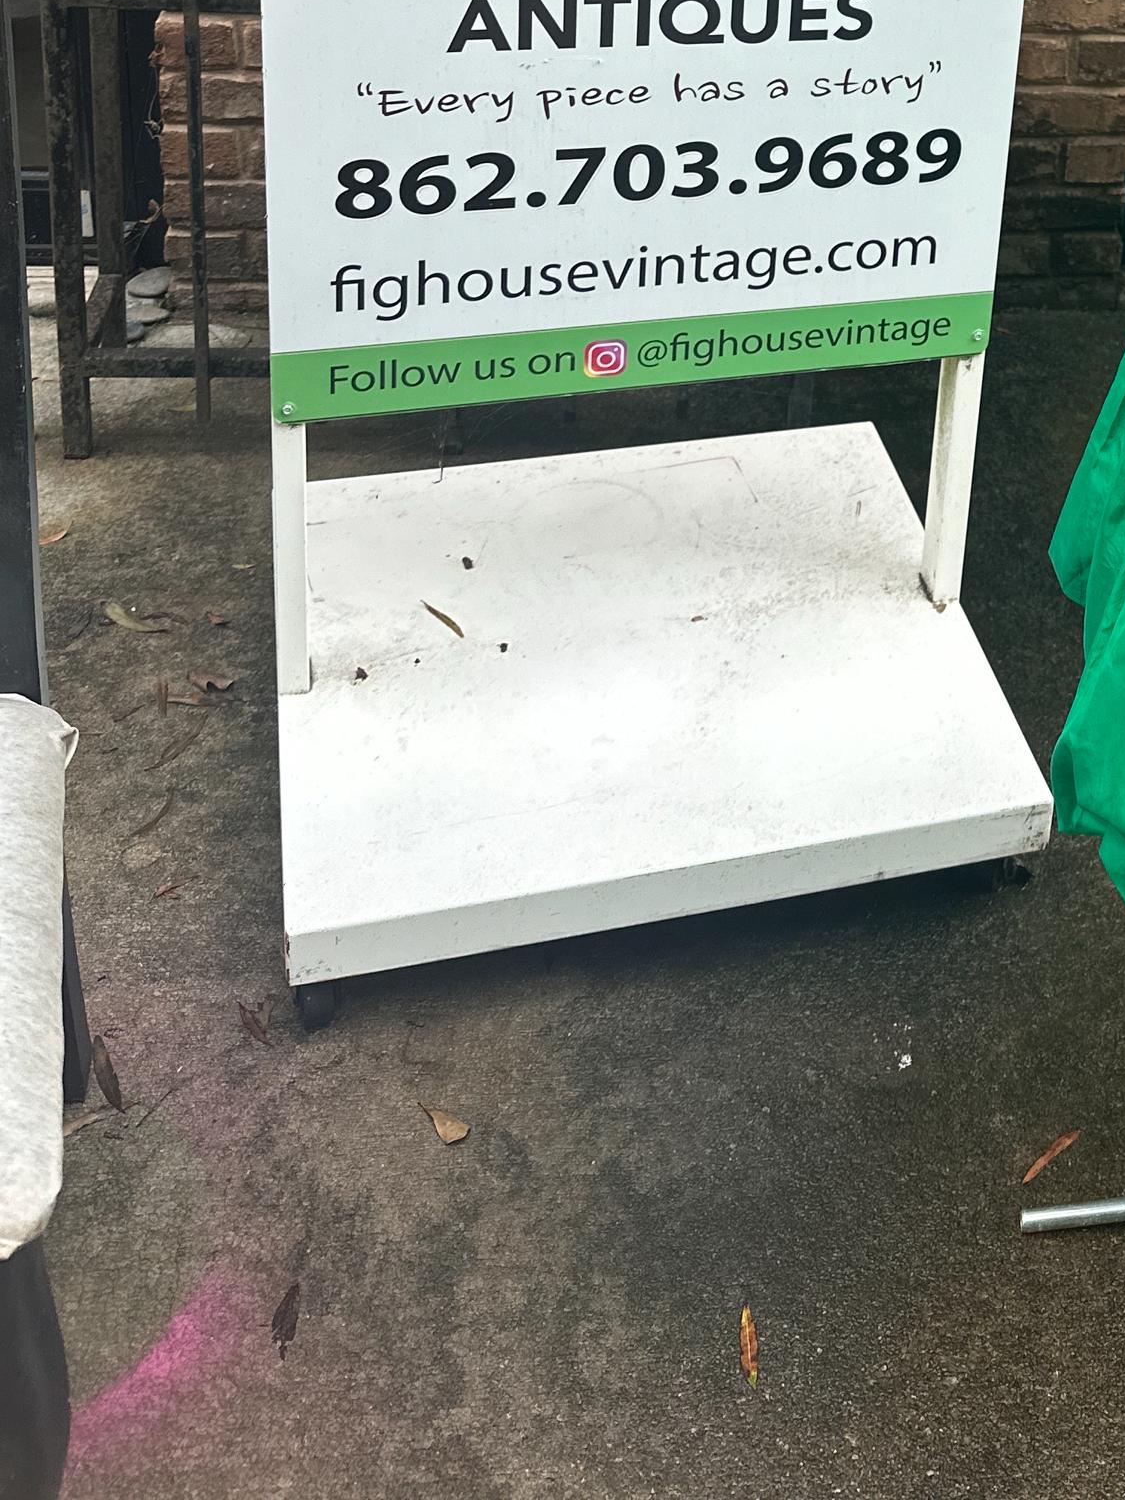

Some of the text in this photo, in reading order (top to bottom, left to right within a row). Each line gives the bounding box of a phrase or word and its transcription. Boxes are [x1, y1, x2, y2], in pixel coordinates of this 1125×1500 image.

[536, 87, 652, 119] piece
[674, 73, 745, 102] has
[767, 79, 789, 99] a
[335, 128, 962, 220] 862.703.9689
[331, 235, 938, 322] fighousevintage.com
[330, 316, 952, 395] Follow us on @fighousevintage
